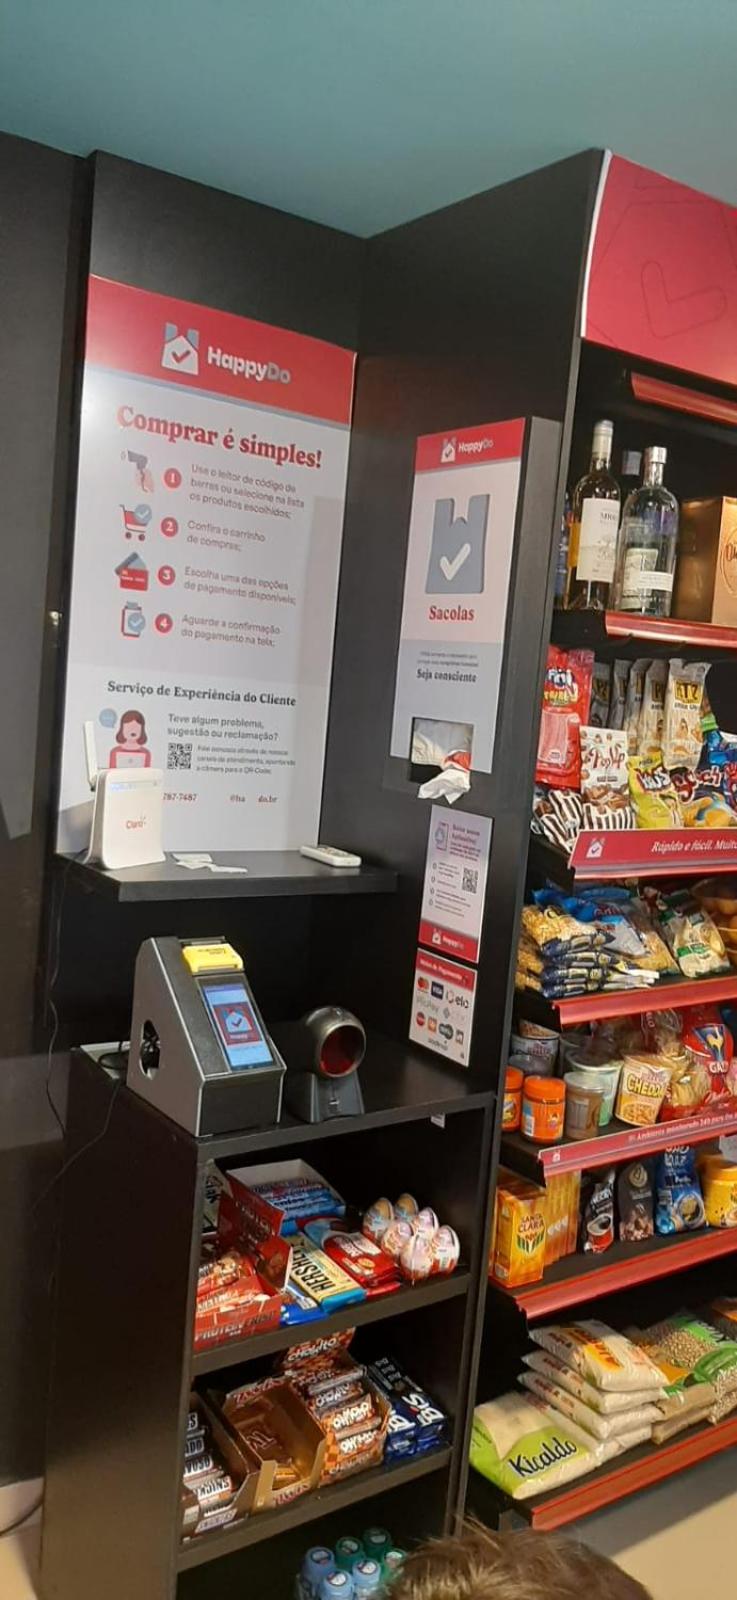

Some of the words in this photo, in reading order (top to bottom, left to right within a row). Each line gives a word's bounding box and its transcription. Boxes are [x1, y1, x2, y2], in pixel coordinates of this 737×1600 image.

[207, 345, 291, 384] HappyDo
[116, 404, 218, 443] Comprar
[223, 429, 234, 449] é
[239, 434, 323, 469] simples!
[458, 438, 494, 454] HappyDo
[191, 463, 209, 475] Use
[218, 469, 240, 483] leitor
[242, 474, 254, 485] de
[255, 476, 285, 493] código
[285, 483, 297, 493] de
[190, 478, 219, 493] barras
[221, 485, 233, 494] ou
[234, 486, 274, 503] selecione
[275, 495, 286, 504] na
[189, 493, 201, 502] os
[202, 494, 242, 510] produtos
[165, 521, 174, 532] 2
[187, 520, 222, 534] Confira
[230, 527, 266, 542] carrinho
[186, 533, 199, 544] de
[184, 566, 219, 580] Escolha
[221, 574, 240, 584] uma
[241, 574, 257, 585] das
[258, 576, 289, 592] opções
[184, 580, 196, 590] de
[197, 582, 247, 598] pagamento
[428, 604, 475, 622] Sacolas
[182, 613, 219, 628] Aguarde
[221, 620, 227, 628] a
[228, 619, 280, 635] confirmação
[181, 628, 193, 637] do
[194, 630, 244, 645] pagamento
[245, 637, 256, 646] na
[416, 668, 433, 682] Seja
[434, 670, 477, 683] consciente
[107, 680, 154, 697] Serviço
[156, 684, 171, 696] de
[173, 686, 241, 703] Experiência
[243, 691, 258, 703] do
[259, 692, 297, 707] Cliente
[168, 714, 190, 724] Teve
[191, 715, 219, 728] algum
[220, 717, 265, 730] problema,
[167, 727, 210, 739] sugestão
[212, 729, 223, 738] ou
[224, 729, 279, 741] reclamação?
[651, 840, 684, 855] Rápido
[684, 842, 691, 852] e
[508, 1436, 578, 1478] Kicaldo
